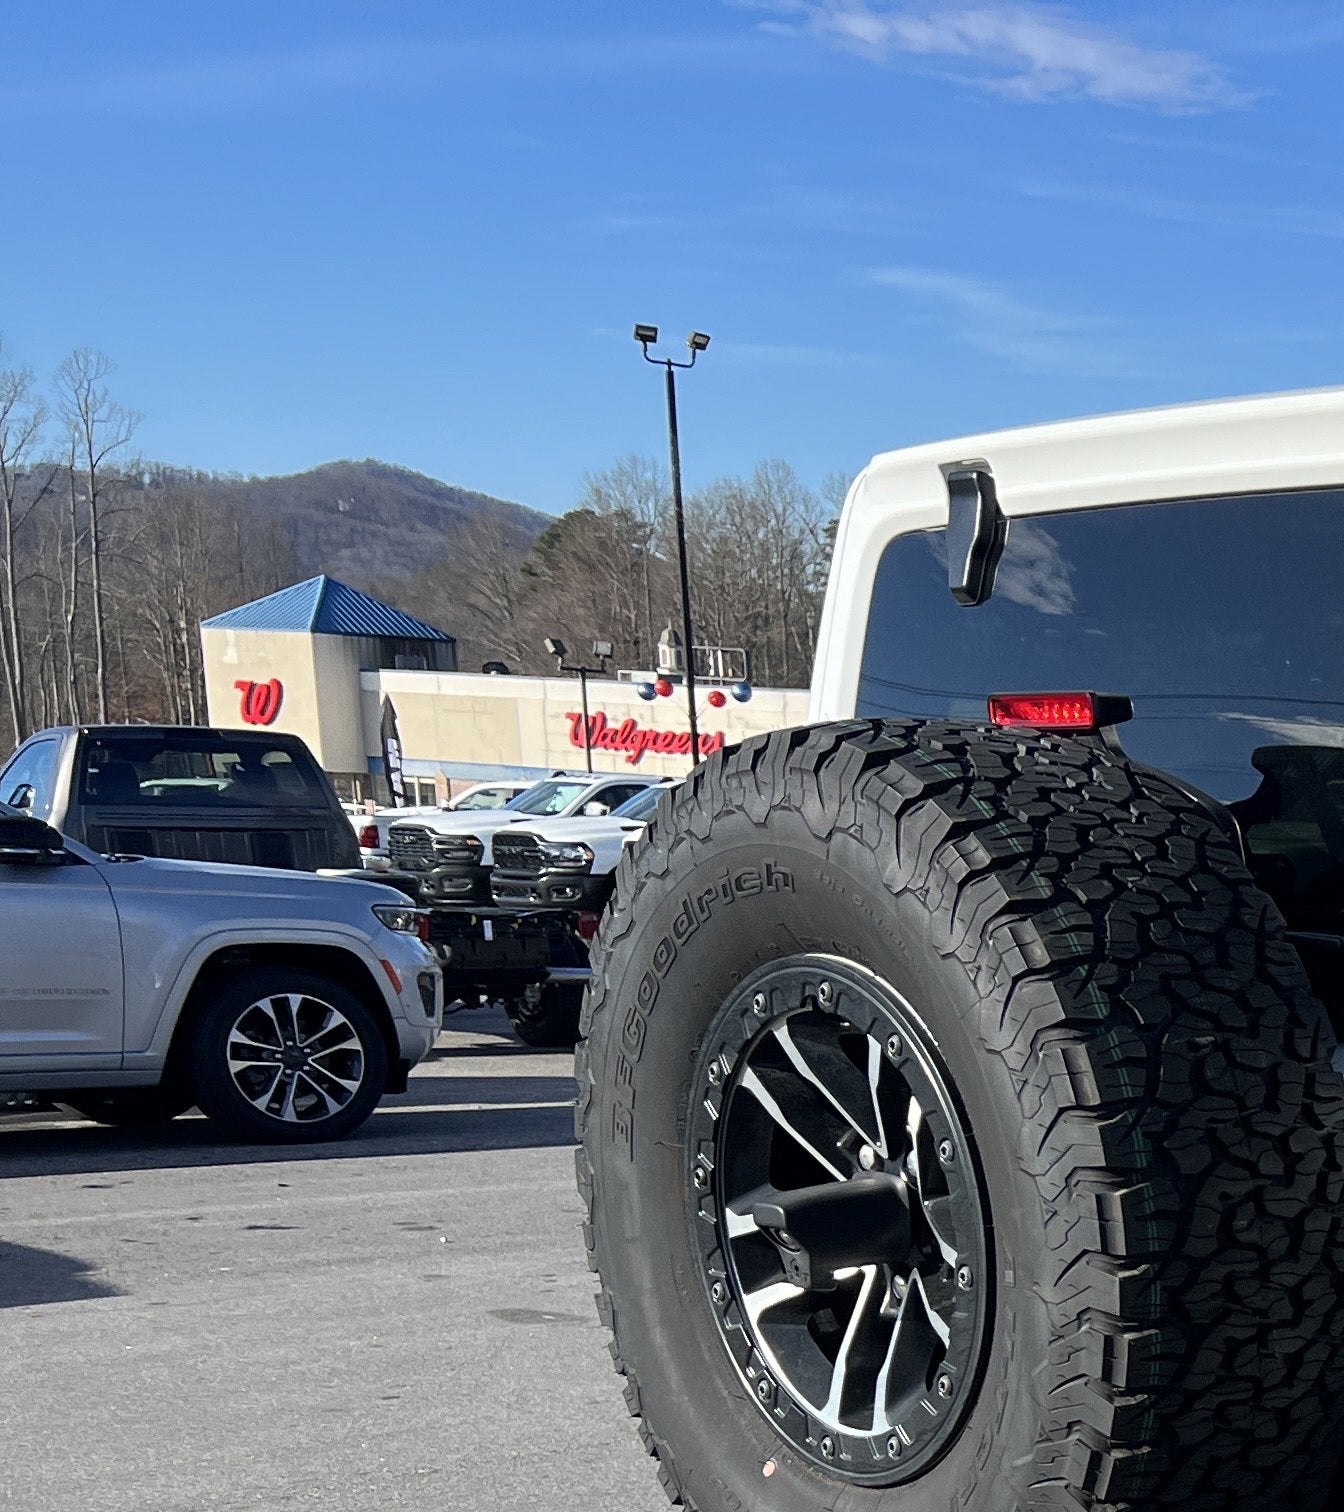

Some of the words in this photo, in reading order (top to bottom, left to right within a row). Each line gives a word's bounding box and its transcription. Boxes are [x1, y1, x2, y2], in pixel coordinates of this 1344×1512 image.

[234, 678, 283, 726] W
[565, 711, 725, 766] Walgreens
[612, 858, 796, 1163] BFGoodrich
